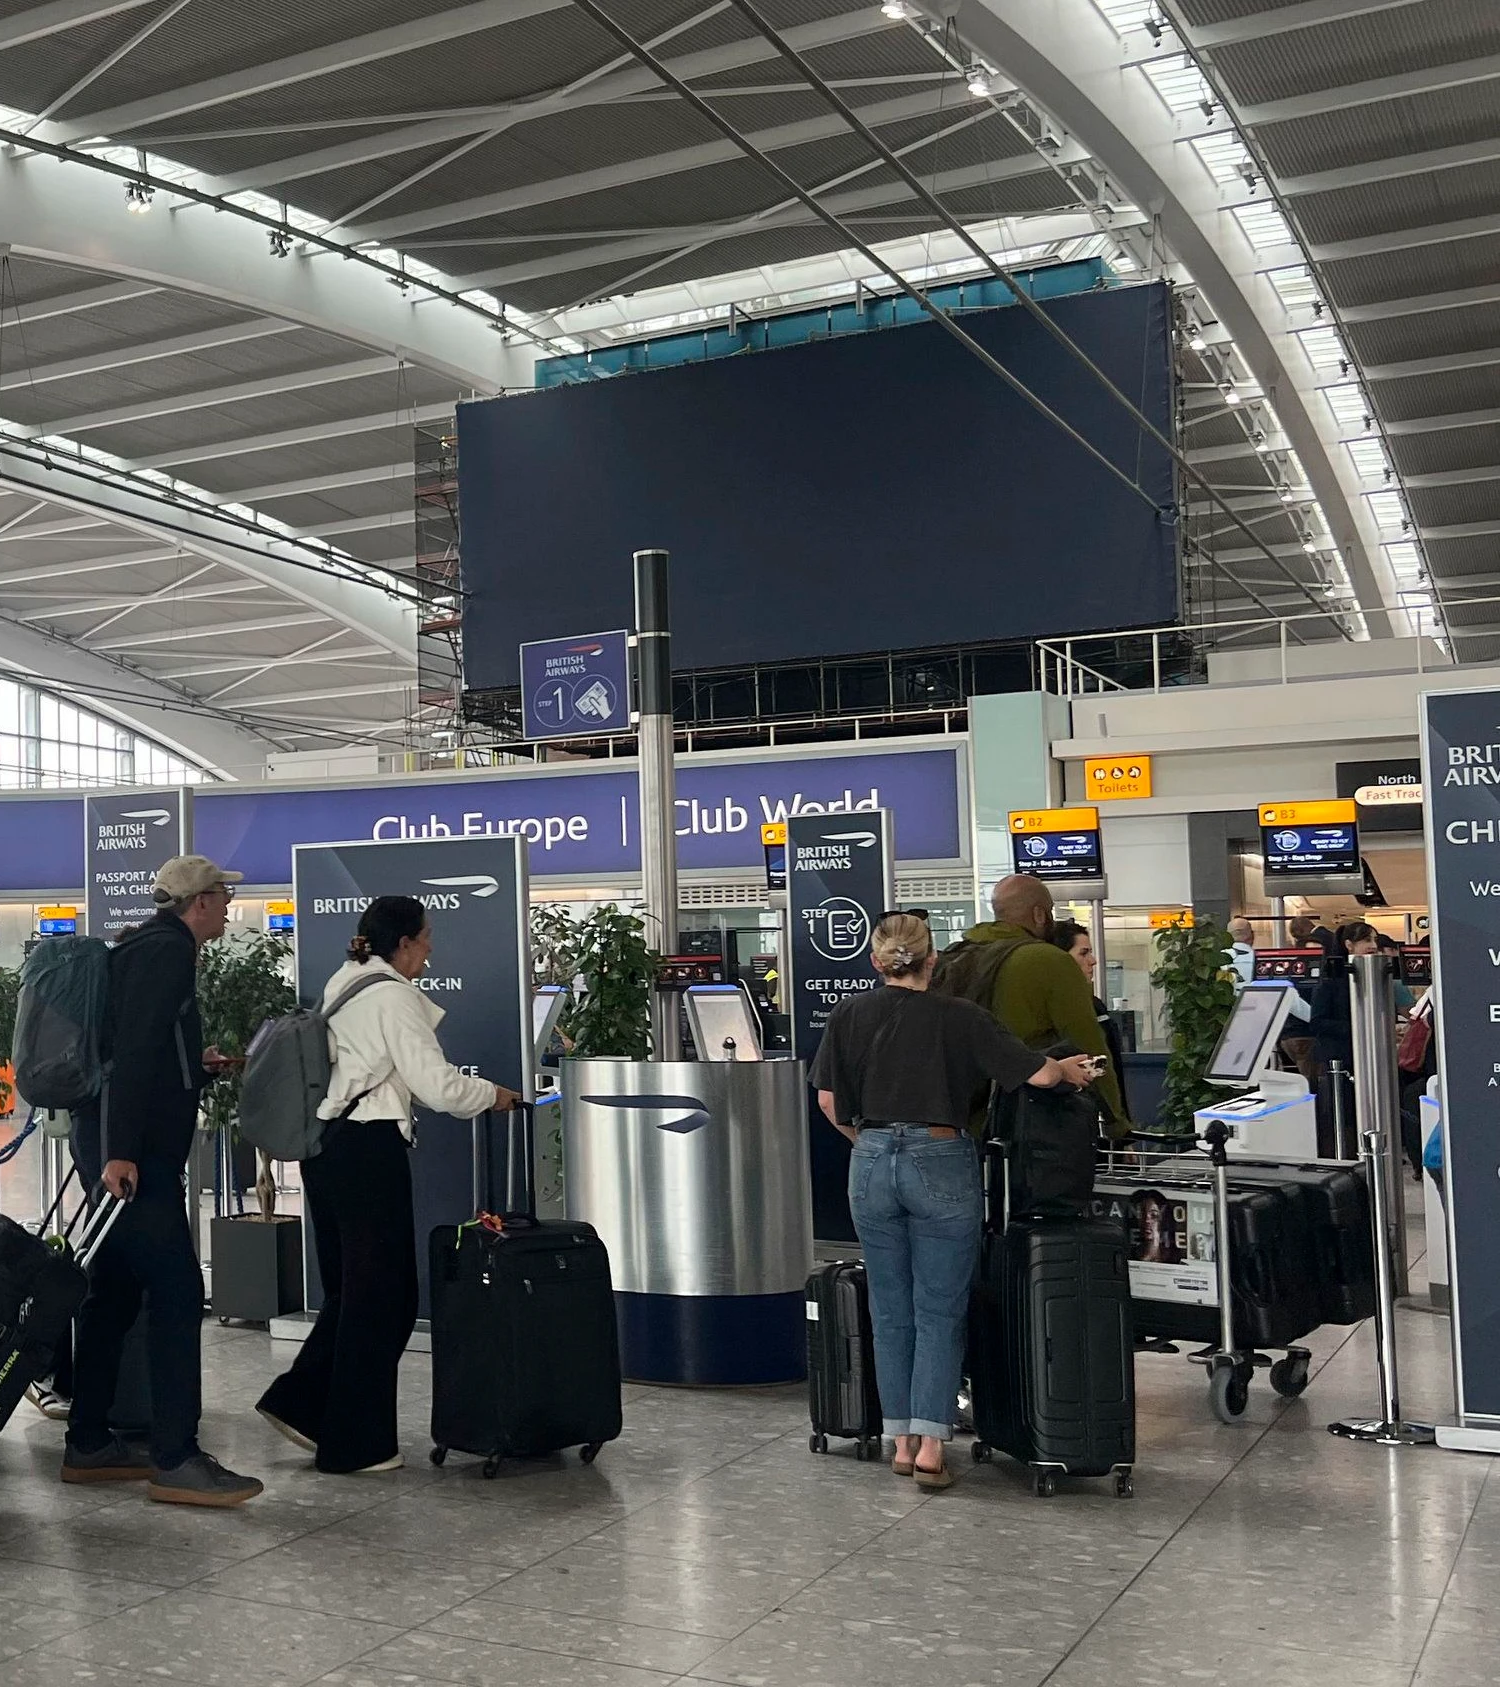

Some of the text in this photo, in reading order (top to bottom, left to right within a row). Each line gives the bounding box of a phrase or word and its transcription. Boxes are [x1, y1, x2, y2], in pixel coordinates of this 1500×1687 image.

[546, 655, 584, 668] BRITISH
[545, 664, 586, 677] AIRWAYS
[553, 687, 564, 720] 1
[1378, 774, 1416, 785] North
[1098, 783, 1138, 793] Toilets
[1366, 790, 1422, 800] Fast Trac
[674, 797, 748, 836] Club
[1280, 810, 1296, 819] B3
[1028, 818, 1042, 827] B2
[99, 823, 145, 837] BRITISH
[96, 836, 147, 850] AIRWAYS
[797, 846, 850, 859] BRITISH
[795, 858, 852, 872] AIRWAYS
[95, 871, 146, 883] PASSPORT
[103, 884, 155, 896] VISA CHEC
[418, 893, 460, 910] WAYS
[108, 907, 122, 917] We
[802, 909, 829, 919] STEP
[103, 921, 144, 929] customer
[807, 920, 815, 934] 1
[411, 978, 462, 990] ECK-IN
[805, 979, 876, 990] GET READY
[819, 993, 838, 1004] TO
